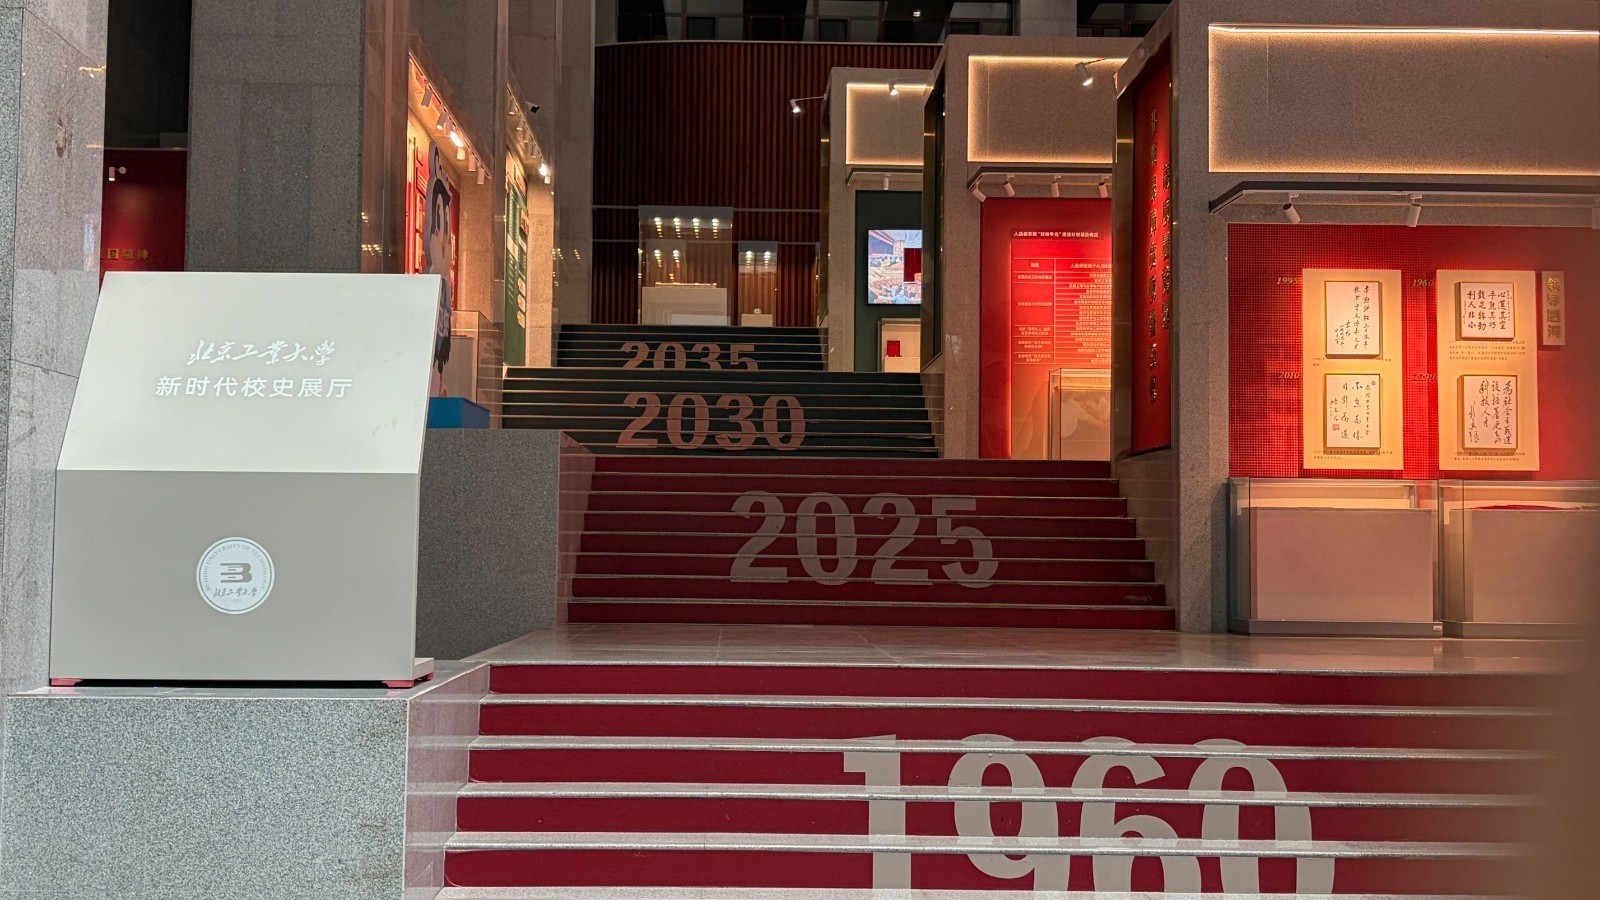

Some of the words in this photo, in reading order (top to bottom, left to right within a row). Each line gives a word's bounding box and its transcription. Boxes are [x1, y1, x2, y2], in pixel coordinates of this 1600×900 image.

[1411, 278, 1434, 287] 1960
[619, 341, 760, 370] 2035
[155, 376, 353, 399] 新时代校史展厅
[616, 392, 807, 451] 2030
[730, 490, 999, 589] 2025
[843, 733, 1336, 894] 1960
